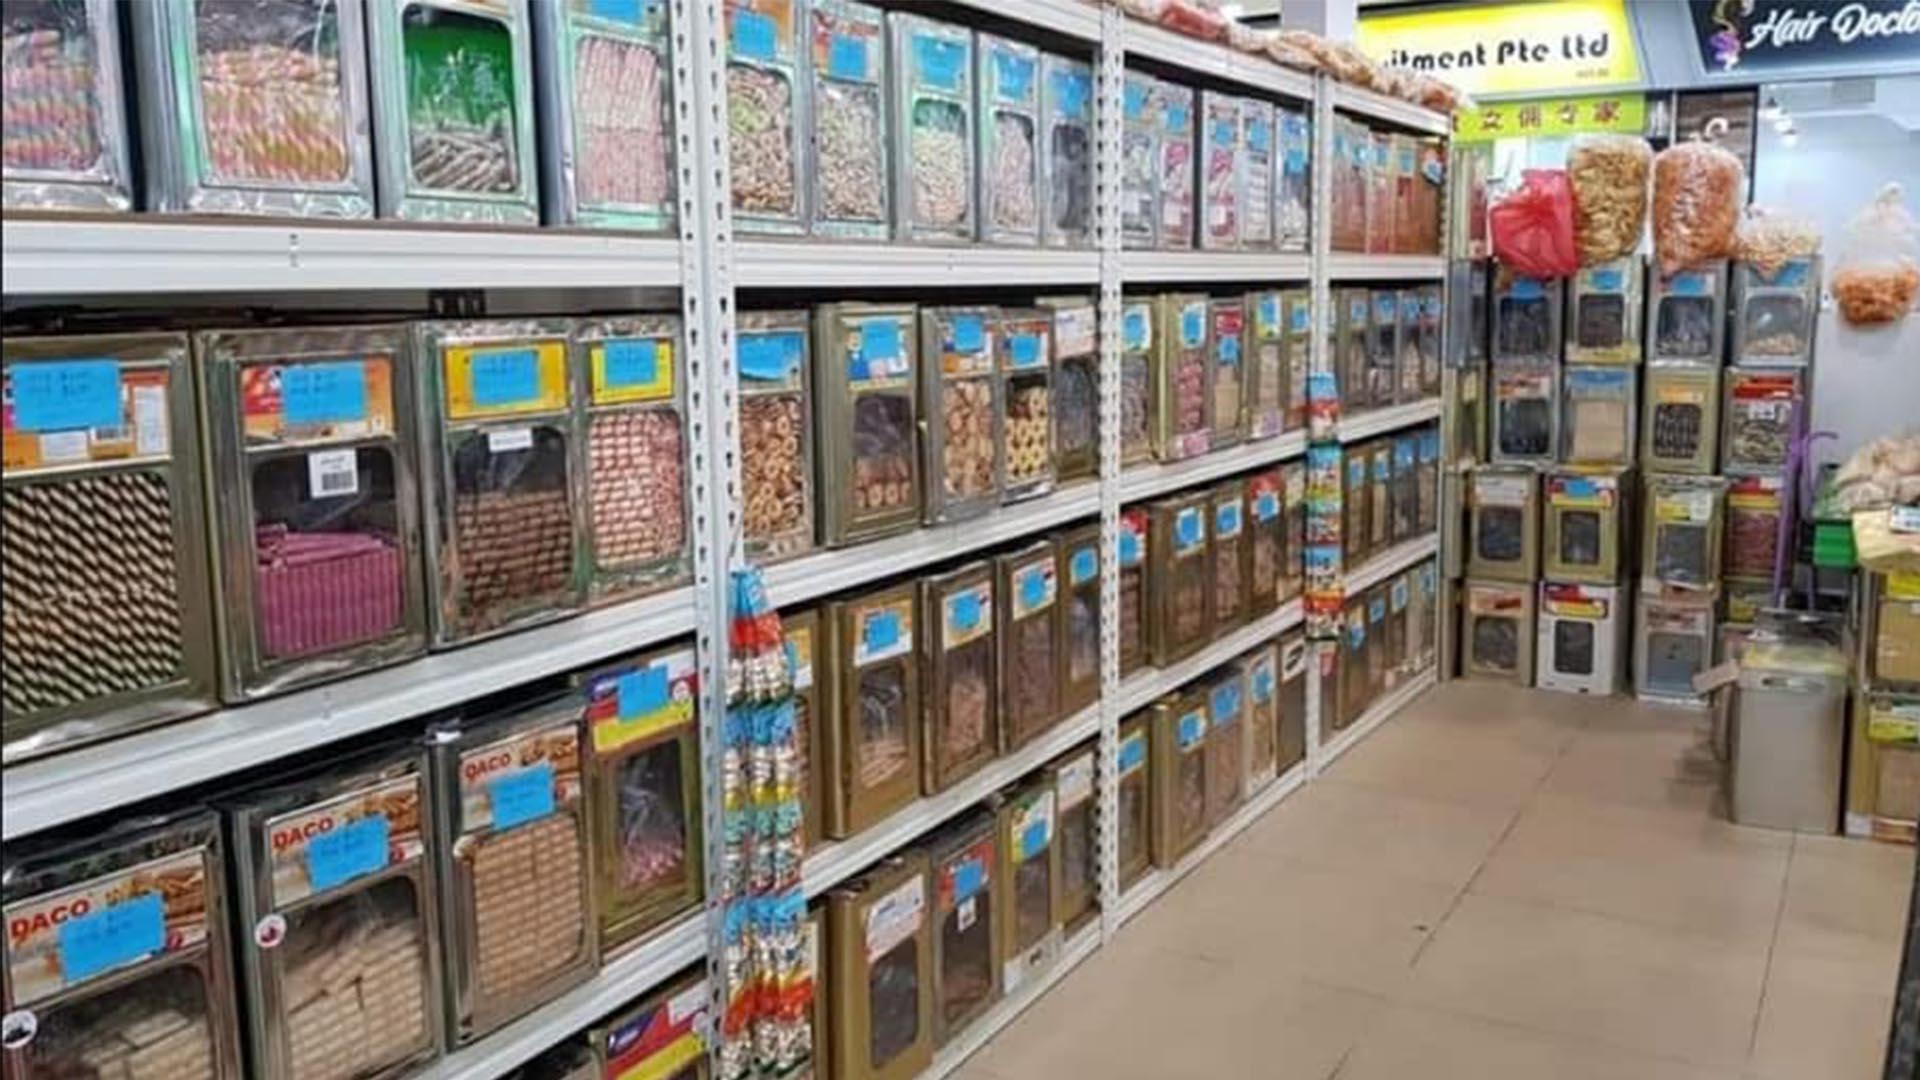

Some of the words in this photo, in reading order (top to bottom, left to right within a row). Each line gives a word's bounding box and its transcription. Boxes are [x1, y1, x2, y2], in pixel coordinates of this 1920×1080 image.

[1745, 8, 1828, 49] Hair
[1497, 39, 1550, 65] Pte
[1562, 33, 1609, 60] Ltd
[463, 753, 511, 780] DACO
[273, 817, 334, 850] DACO
[11, 899, 90, 946] DACO
